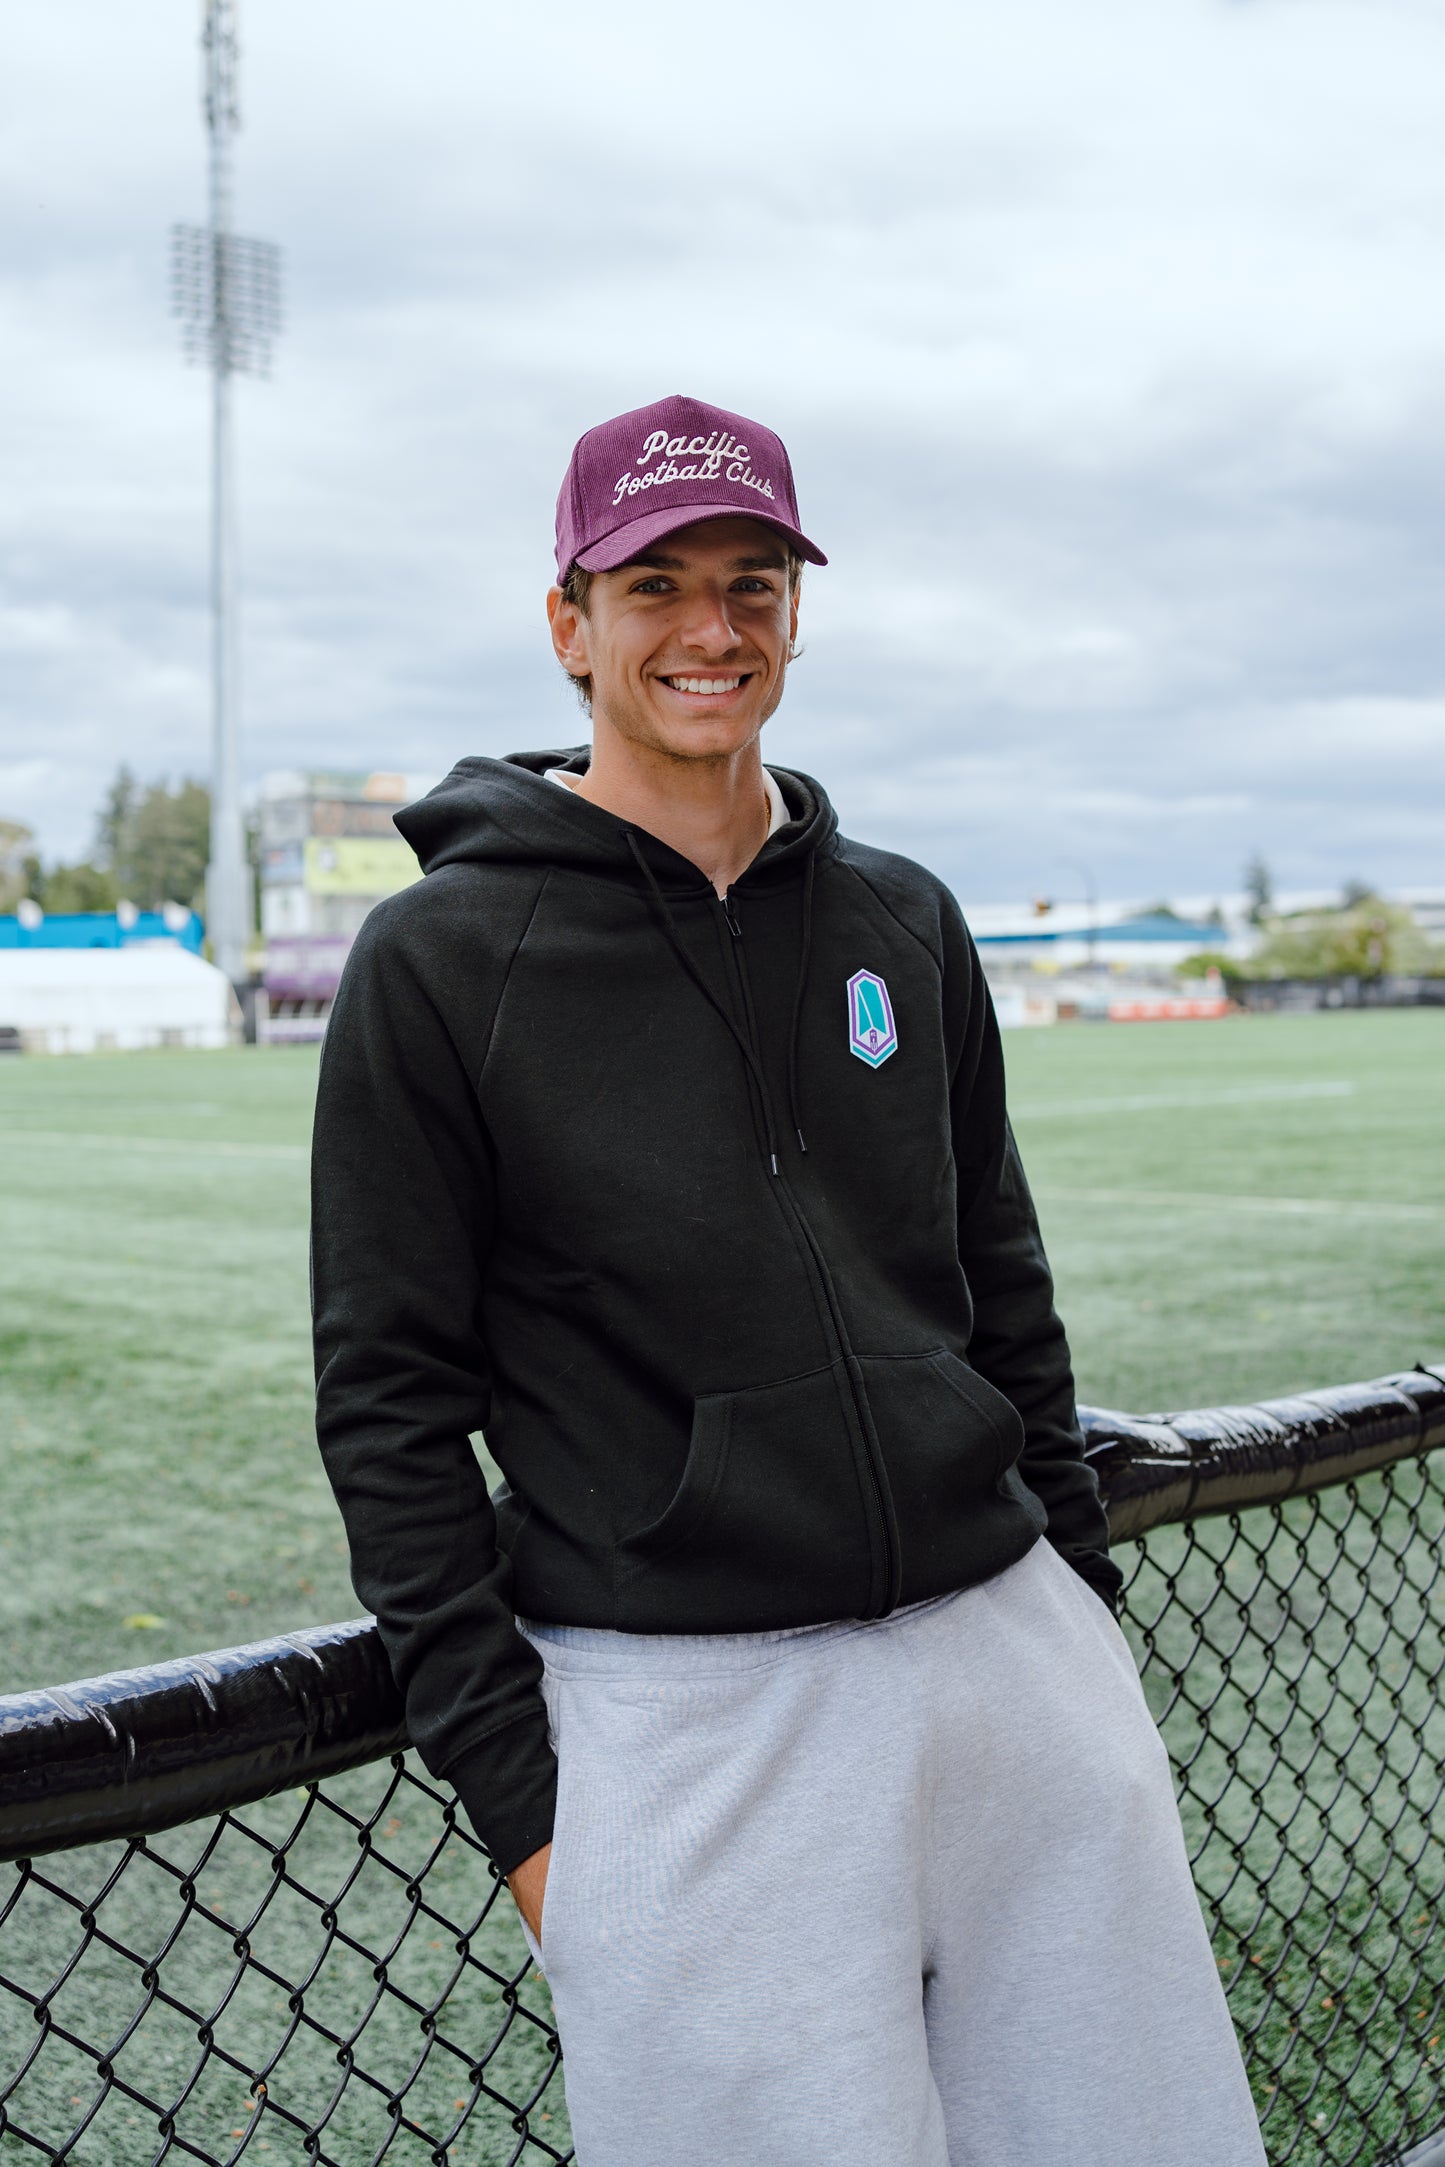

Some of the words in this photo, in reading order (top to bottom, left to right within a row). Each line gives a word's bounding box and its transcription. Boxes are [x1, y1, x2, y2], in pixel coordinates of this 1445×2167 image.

[637, 430, 751, 469] Pacific
[612, 459, 720, 505] Football
[726, 462, 775, 500] Club
